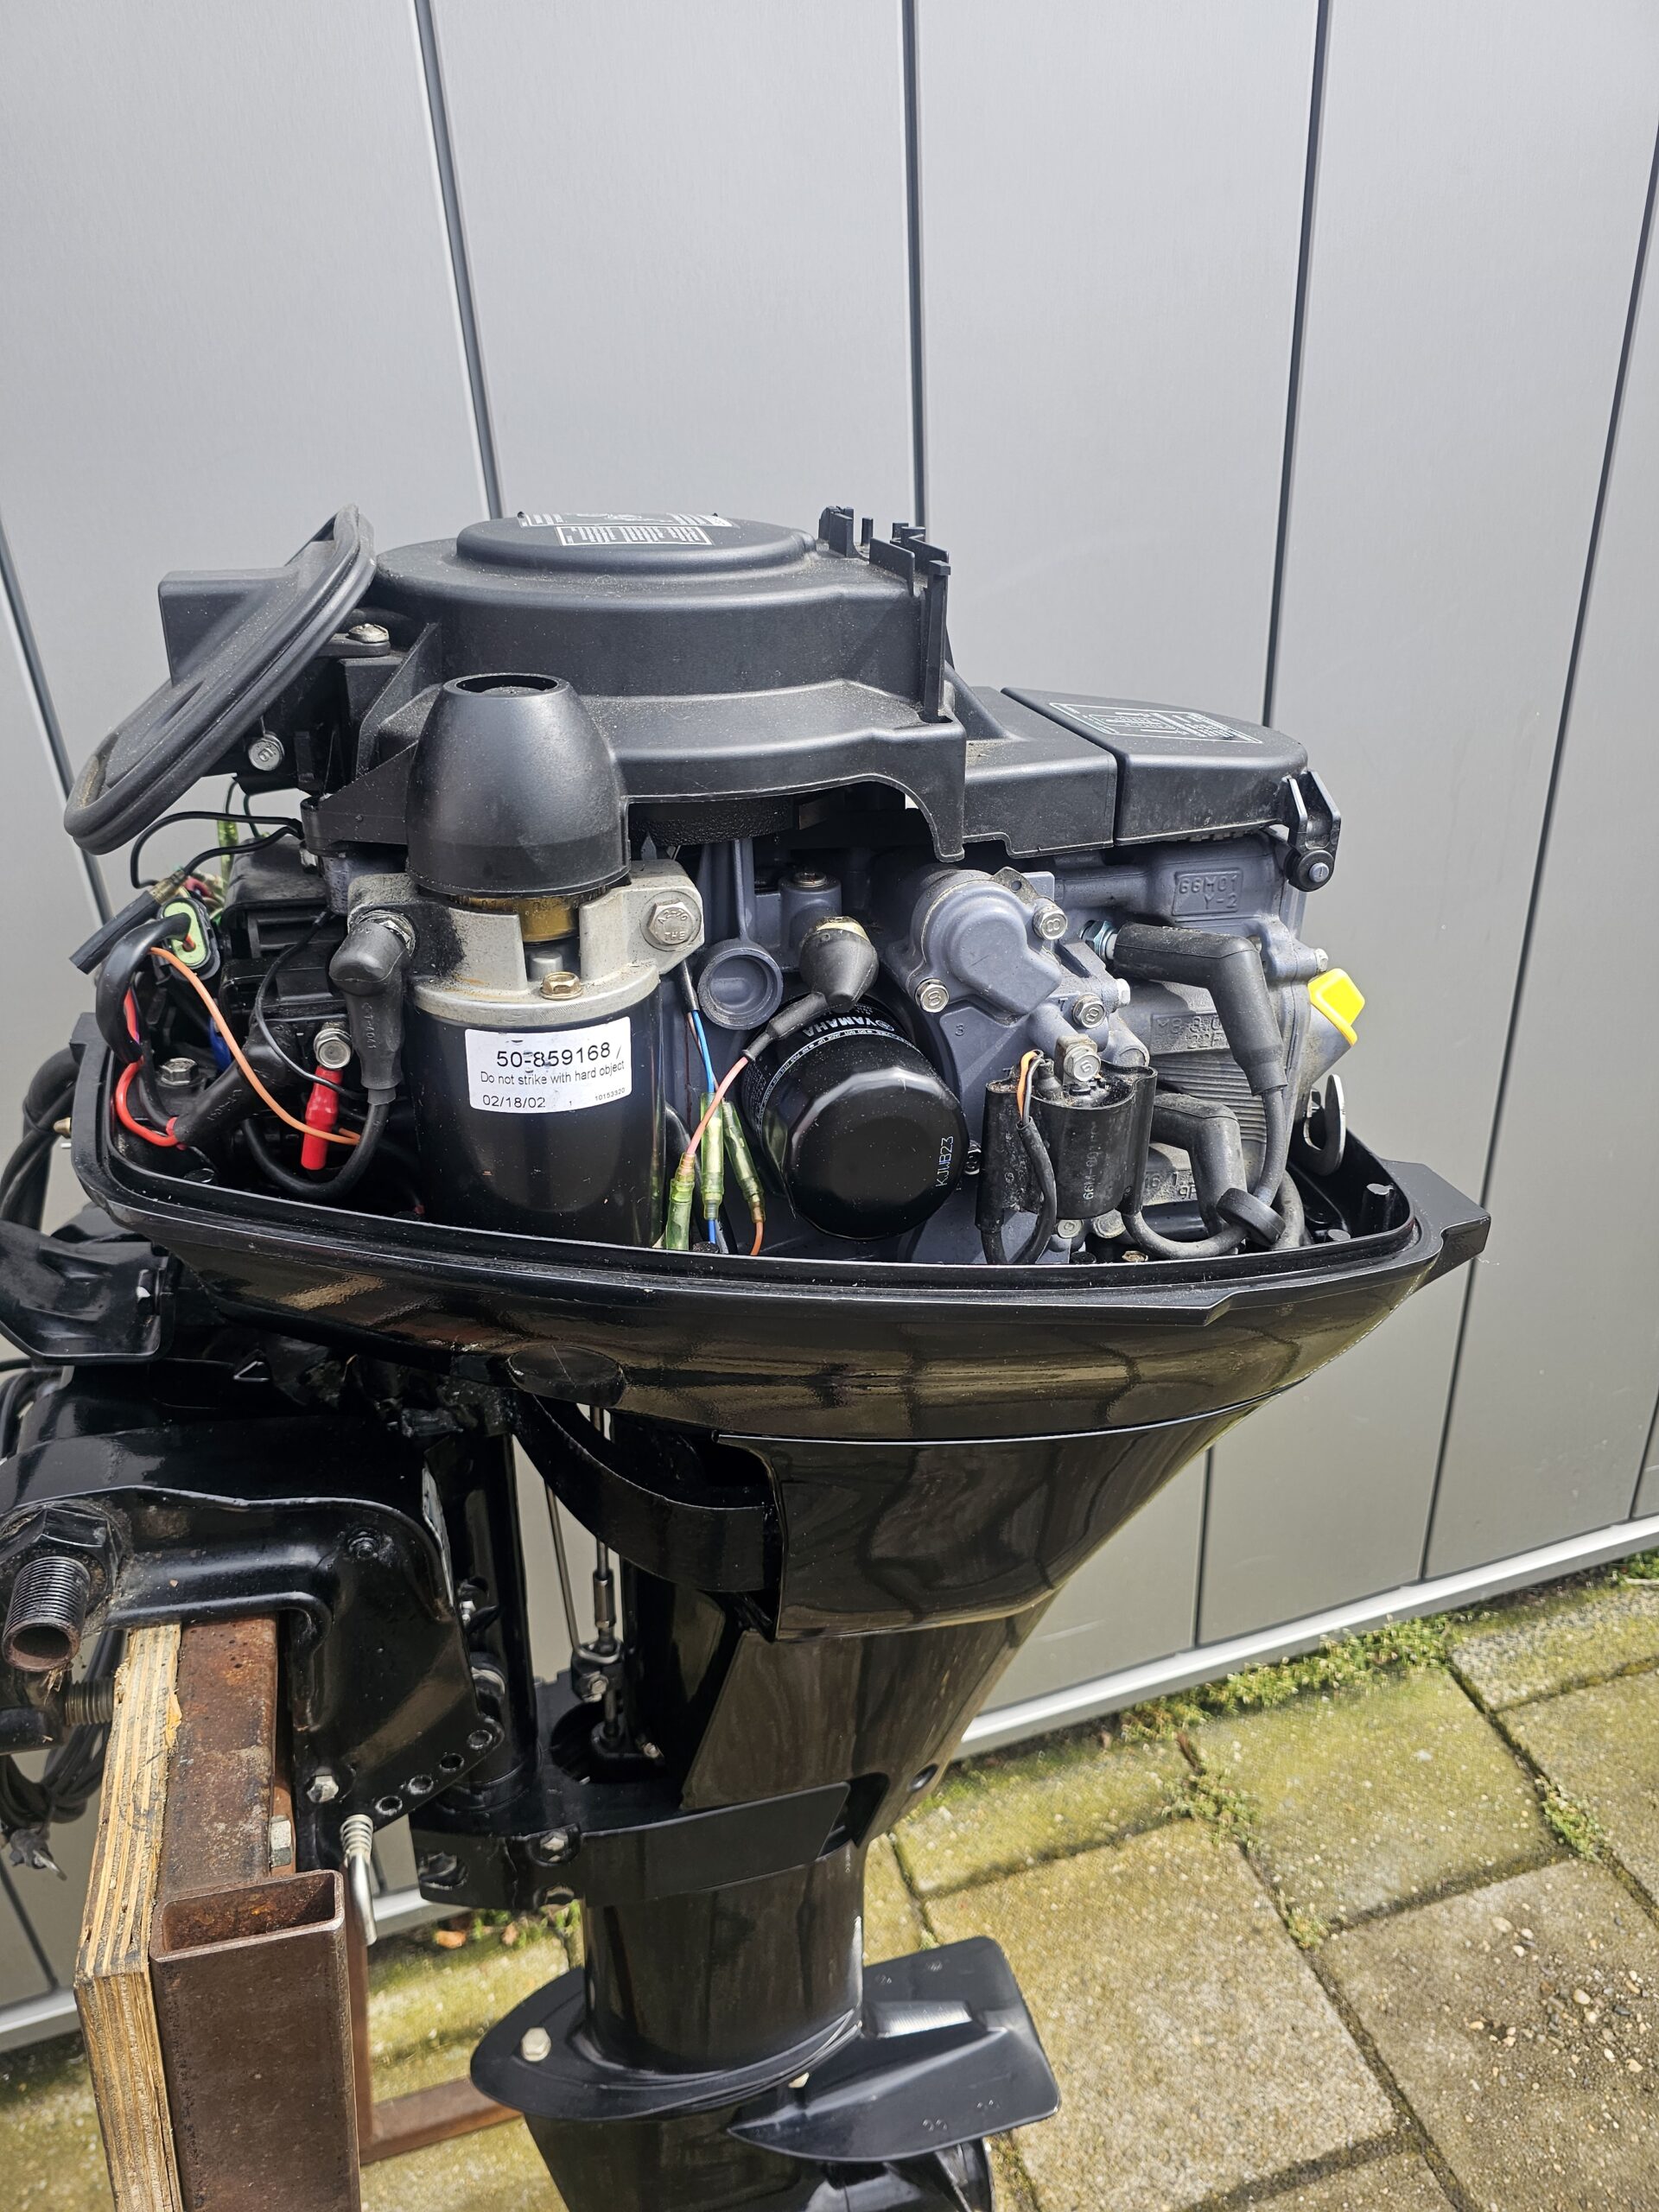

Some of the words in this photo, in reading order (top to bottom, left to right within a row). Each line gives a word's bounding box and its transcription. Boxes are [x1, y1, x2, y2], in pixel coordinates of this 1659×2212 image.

[664, 931, 685, 941] THE
[802, 1016, 878, 1037] YAMAHA
[496, 1041, 611, 1067] 50-859168
[480, 1071, 494, 1084] Do
[498, 1073, 514, 1084] not
[518, 1073, 548, 1085] strike
[550, 1072, 572, 1084] with
[575, 1067, 596, 1082] hard
[599, 1060, 625, 1077] object
[482, 1094, 546, 1109] 02/18/02
[935, 1135, 954, 1187] KJWB23
